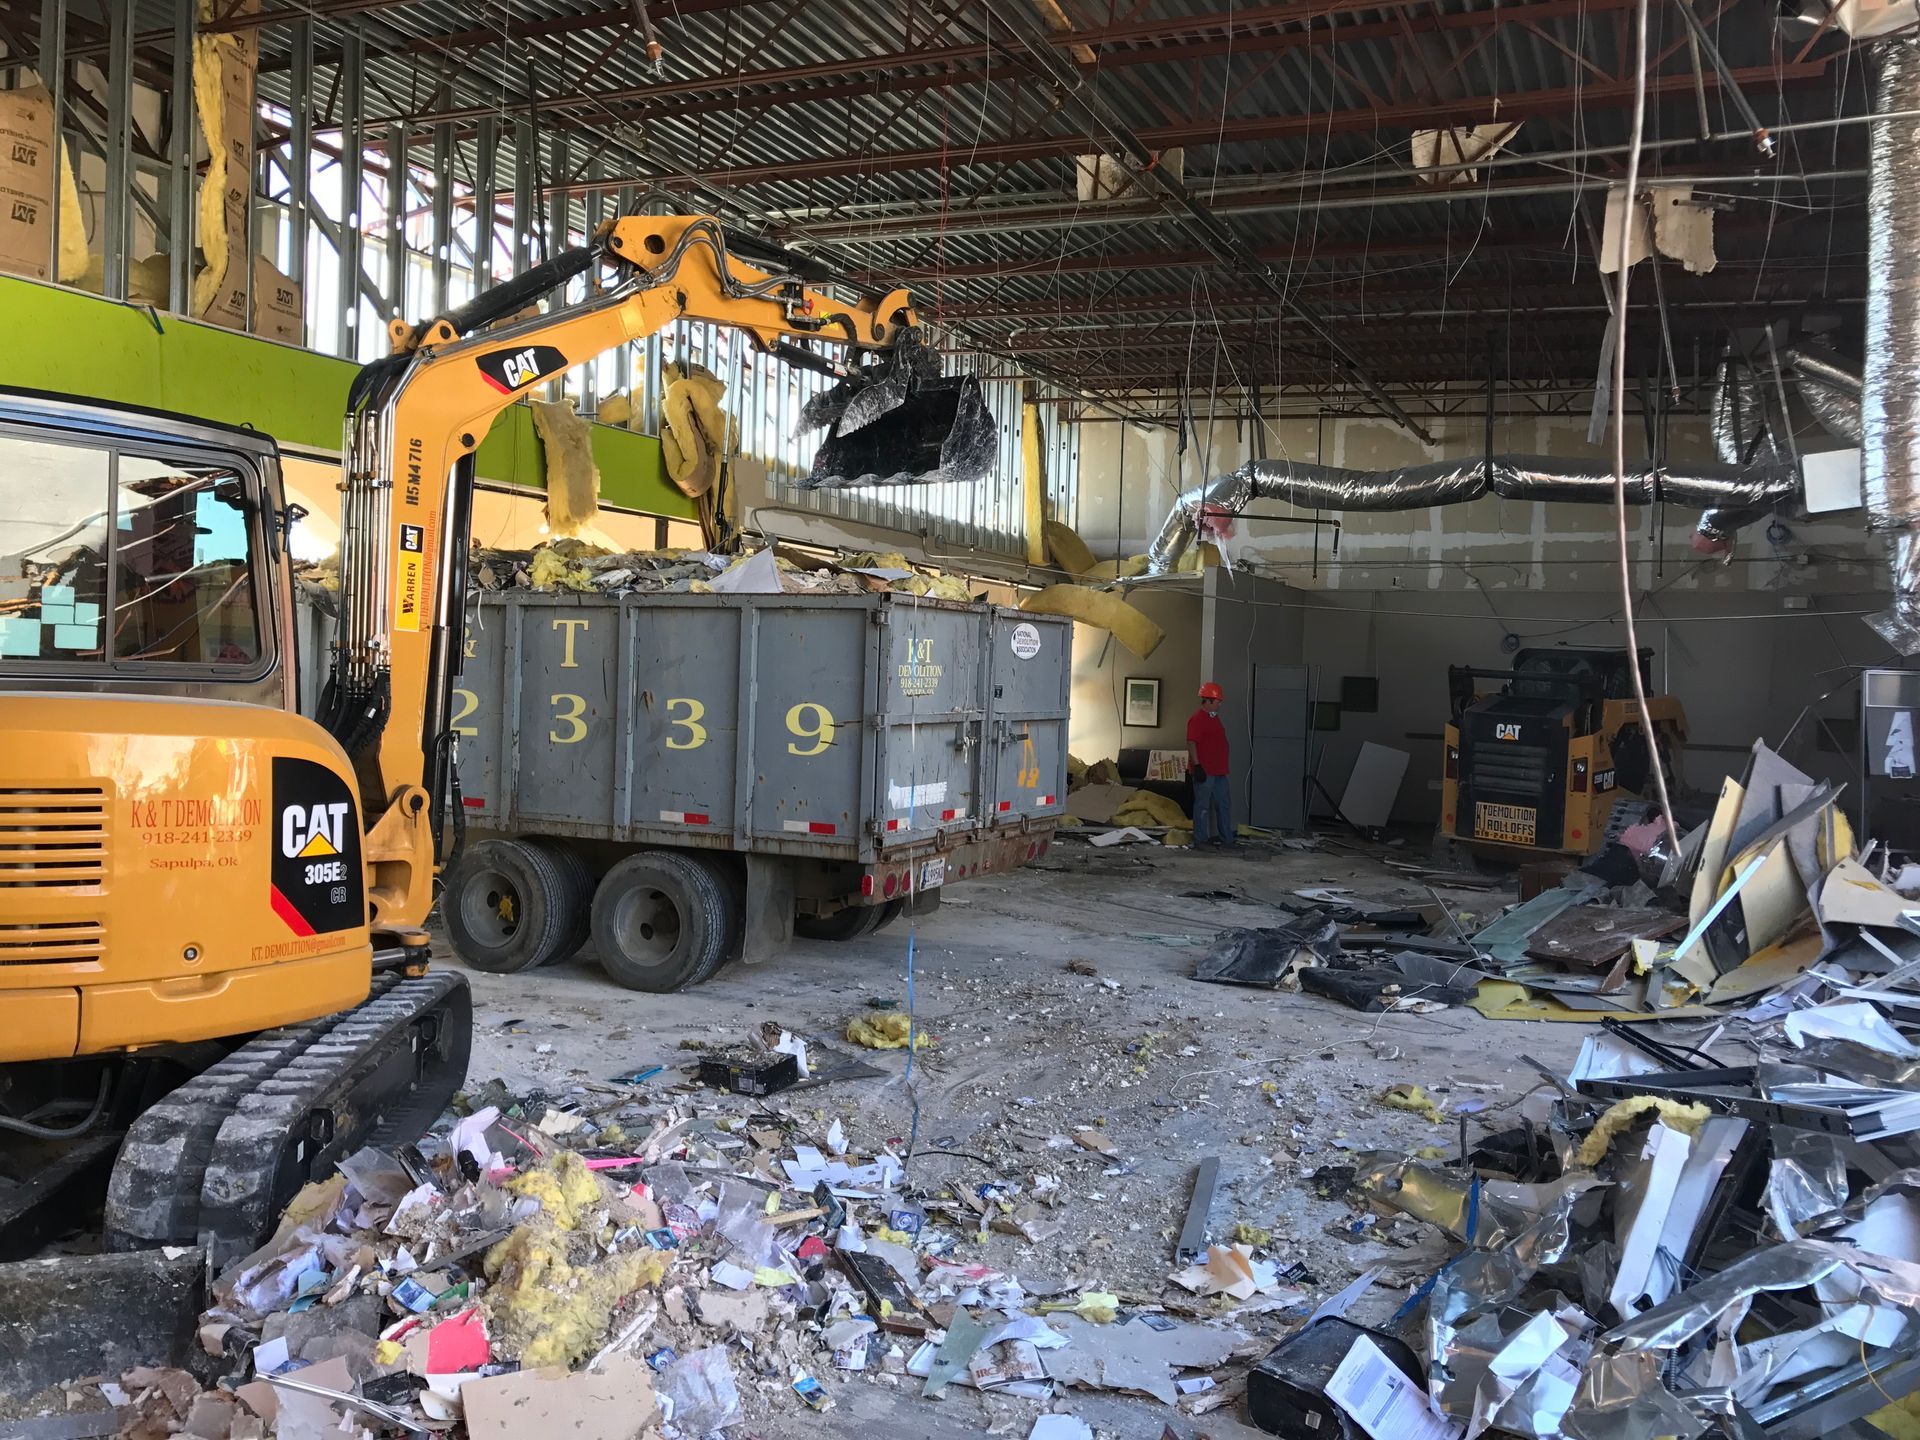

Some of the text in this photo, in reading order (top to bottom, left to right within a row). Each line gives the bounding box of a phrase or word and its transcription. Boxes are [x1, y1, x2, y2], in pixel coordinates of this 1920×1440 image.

[503, 348, 540, 388] CAT
[405, 526, 419, 551] CAT
[402, 562, 416, 614] WARREN
[552, 619, 589, 668] T
[451, 689, 835, 756] 2 3 3 9
[1496, 723, 1522, 741] CAT
[131, 799, 262, 828] K & T DEMOLITION
[1487, 804, 1535, 821] DEMOLITION
[142, 829, 252, 845] 918-241-2339
[282, 802, 348, 859] CAT
[1487, 819, 1534, 836] ROLLOFFS
[149, 855, 238, 871] Sapulpa, Ok
[330, 886, 347, 904] CR
